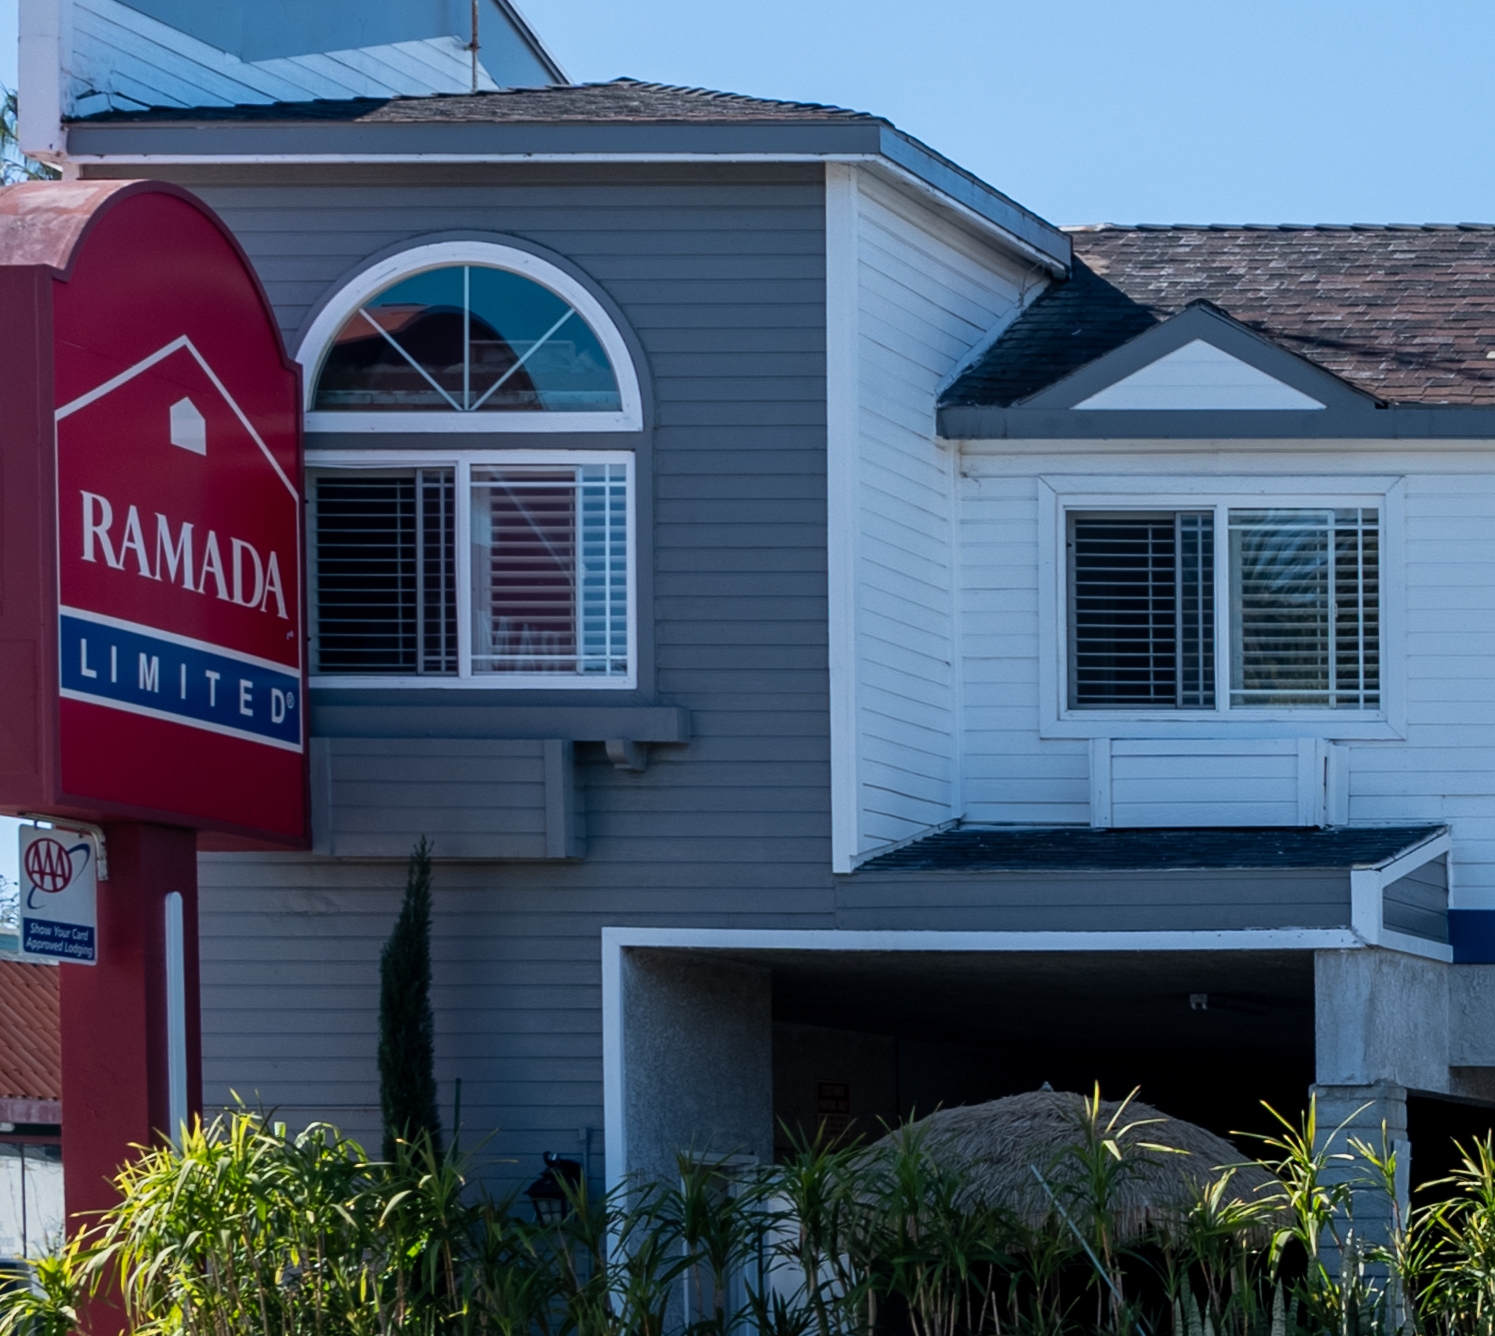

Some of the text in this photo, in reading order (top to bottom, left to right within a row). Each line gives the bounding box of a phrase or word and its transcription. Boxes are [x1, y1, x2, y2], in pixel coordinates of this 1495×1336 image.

[80, 490, 289, 620] RAMADA
[80, 638, 286, 724] LIMITED
[30, 840, 68, 891] AAA
[26, 937, 94, 959] Approved Lodging
[30, 922, 89, 941] Show Your Card
